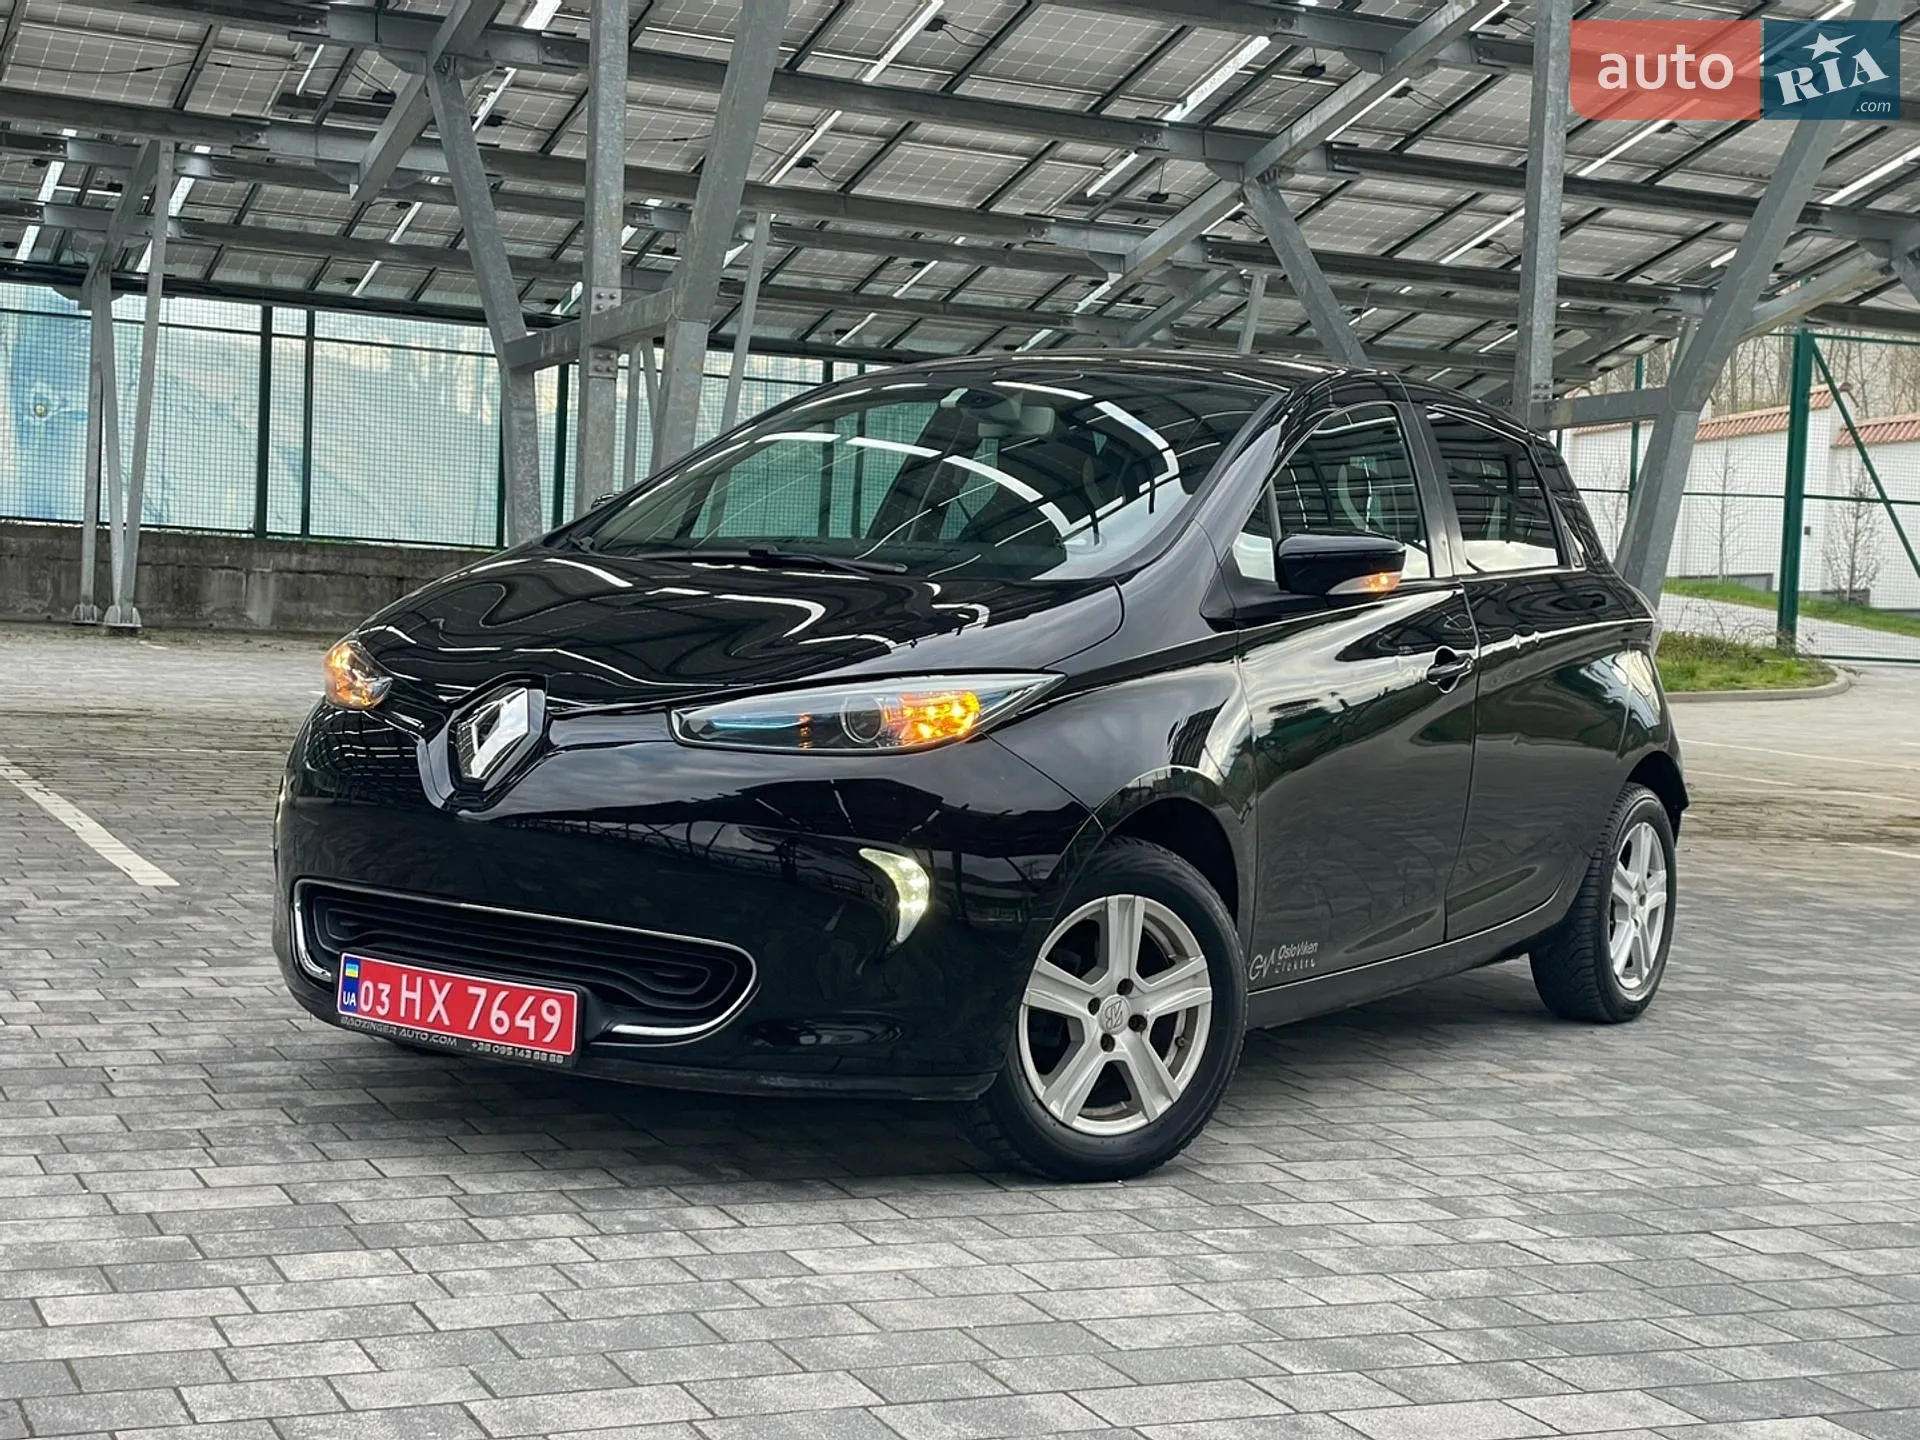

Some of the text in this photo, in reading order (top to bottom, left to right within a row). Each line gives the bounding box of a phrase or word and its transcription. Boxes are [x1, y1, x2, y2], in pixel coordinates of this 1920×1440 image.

[343, 991, 356, 1007] UA
[360, 973, 563, 1043] 03 HX 7649
